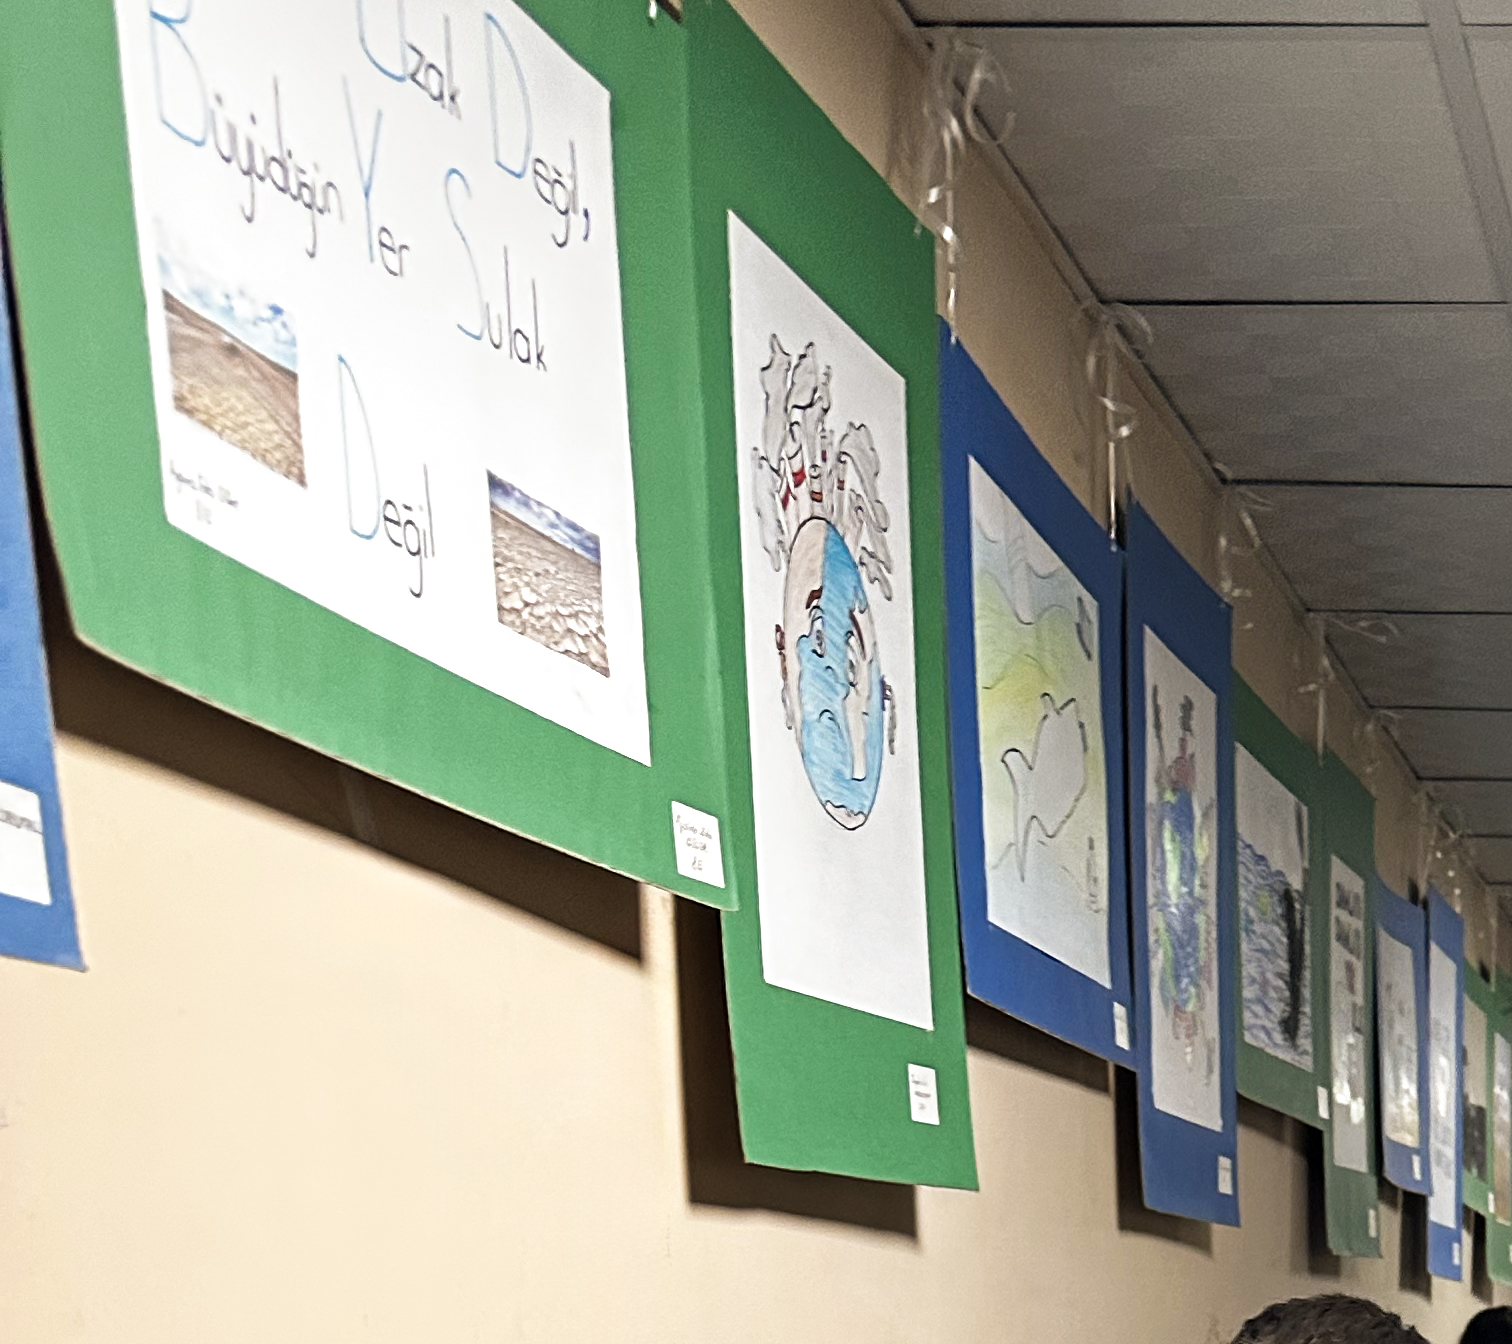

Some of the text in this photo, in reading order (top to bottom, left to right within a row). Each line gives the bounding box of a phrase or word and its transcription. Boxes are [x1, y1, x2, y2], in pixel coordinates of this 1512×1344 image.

[342, 74, 410, 278] Yer
[445, 167, 547, 372] Sulak
[337, 354, 435, 598] Değil
